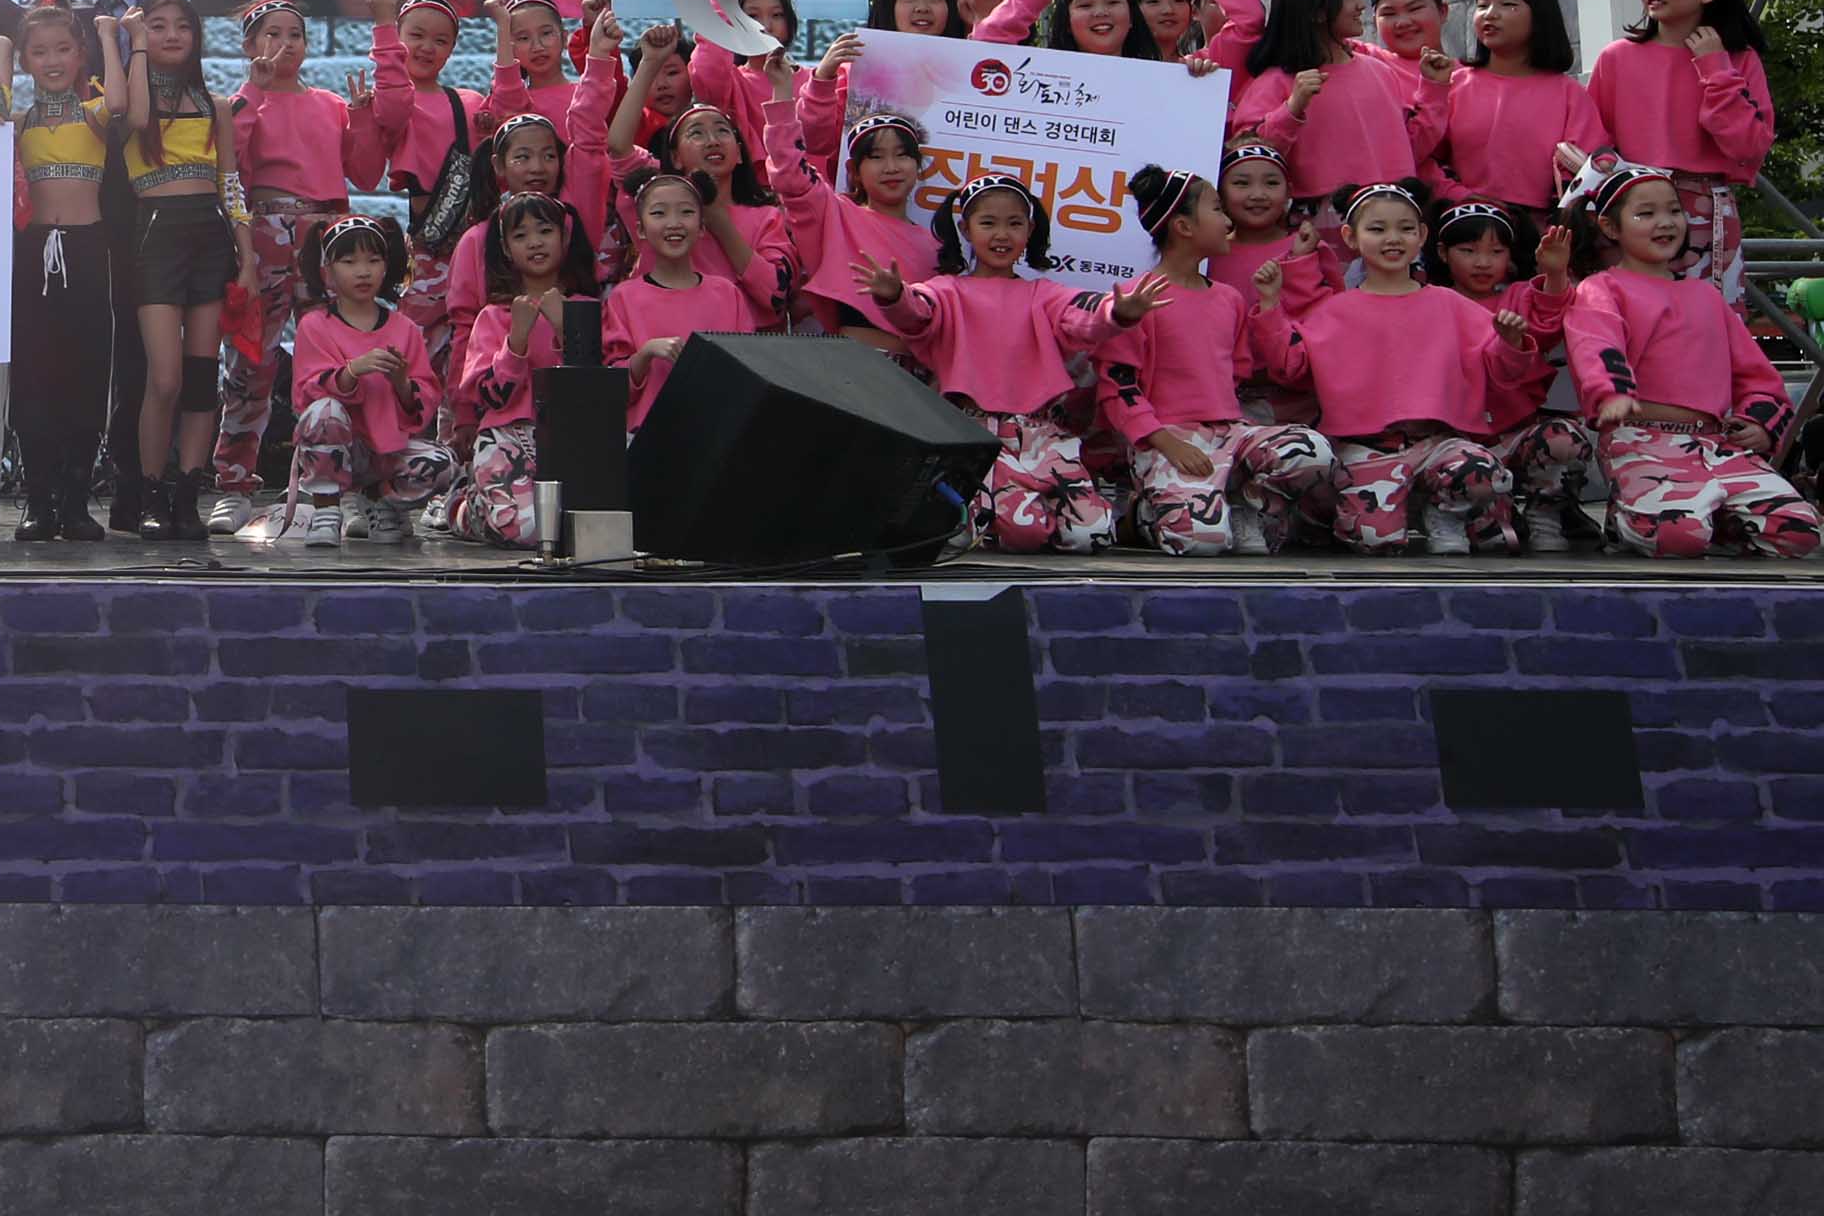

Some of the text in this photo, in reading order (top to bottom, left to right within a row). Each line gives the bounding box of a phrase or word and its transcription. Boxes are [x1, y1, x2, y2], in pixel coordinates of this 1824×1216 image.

[944, 109, 1116, 146] 어린이 댄스 경연대회
[968, 175, 1008, 195] NY
[1079, 260, 1134, 279] 동국제강
